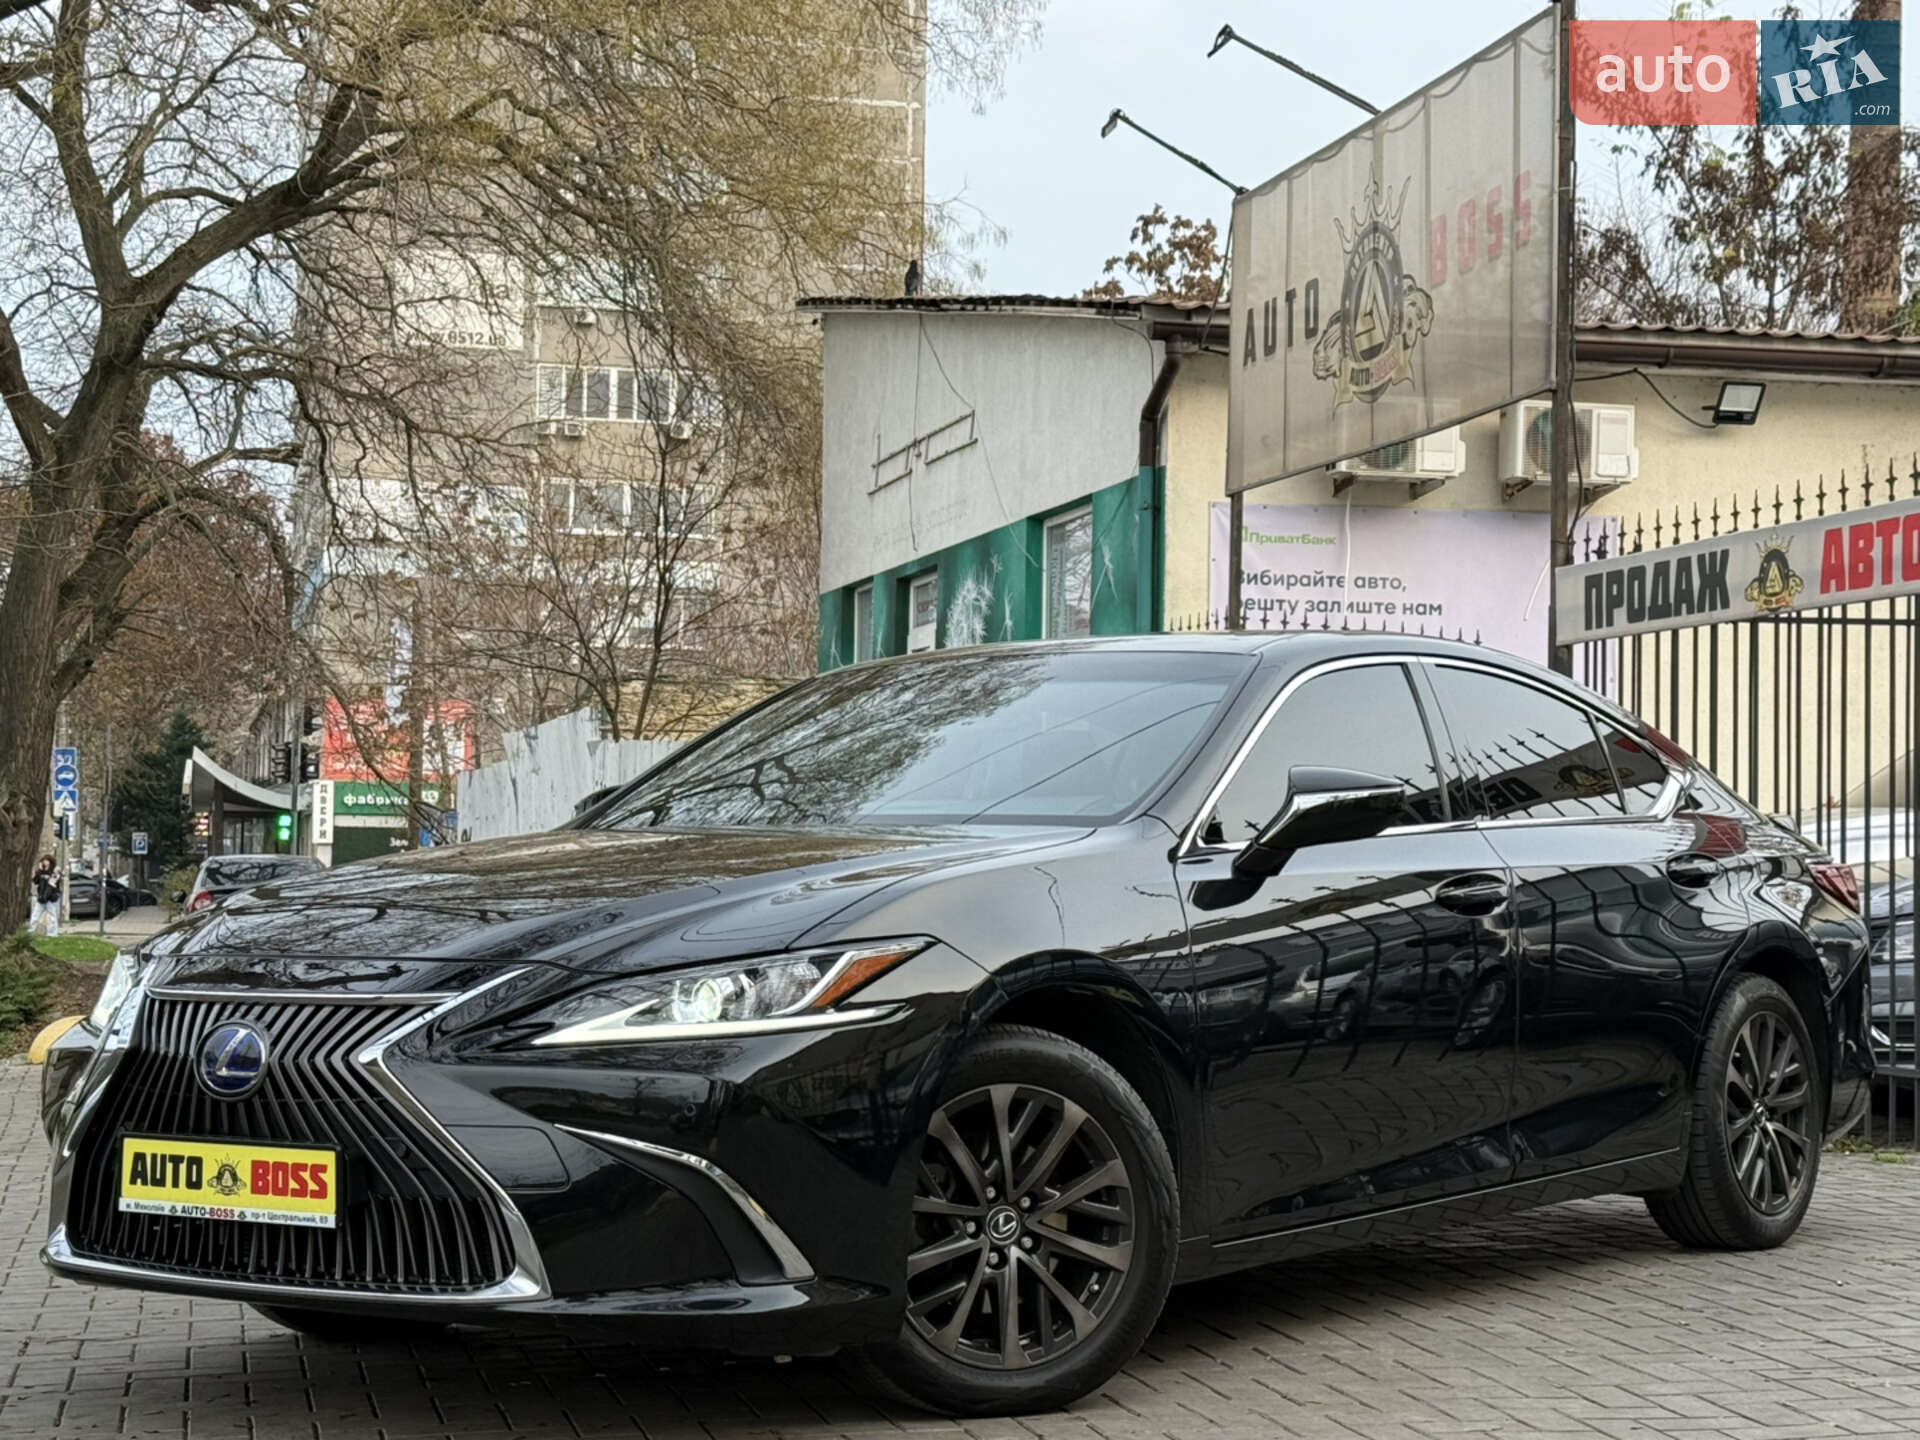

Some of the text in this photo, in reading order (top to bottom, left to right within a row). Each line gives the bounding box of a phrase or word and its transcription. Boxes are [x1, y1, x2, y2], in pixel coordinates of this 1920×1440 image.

[1243, 170, 1532, 368] AUTO BOSS
[1250, 531, 1337, 546] ПриватБанк
[1584, 512, 1920, 631] ПРОДАЖ АВТО
[1354, 576, 1407, 592] авто,
[1240, 597, 1443, 616] ешту залиште нам
[129, 1151, 329, 1200] AUTO BOSS
[181, 1205, 236, 1219] AUTO-BOSS
